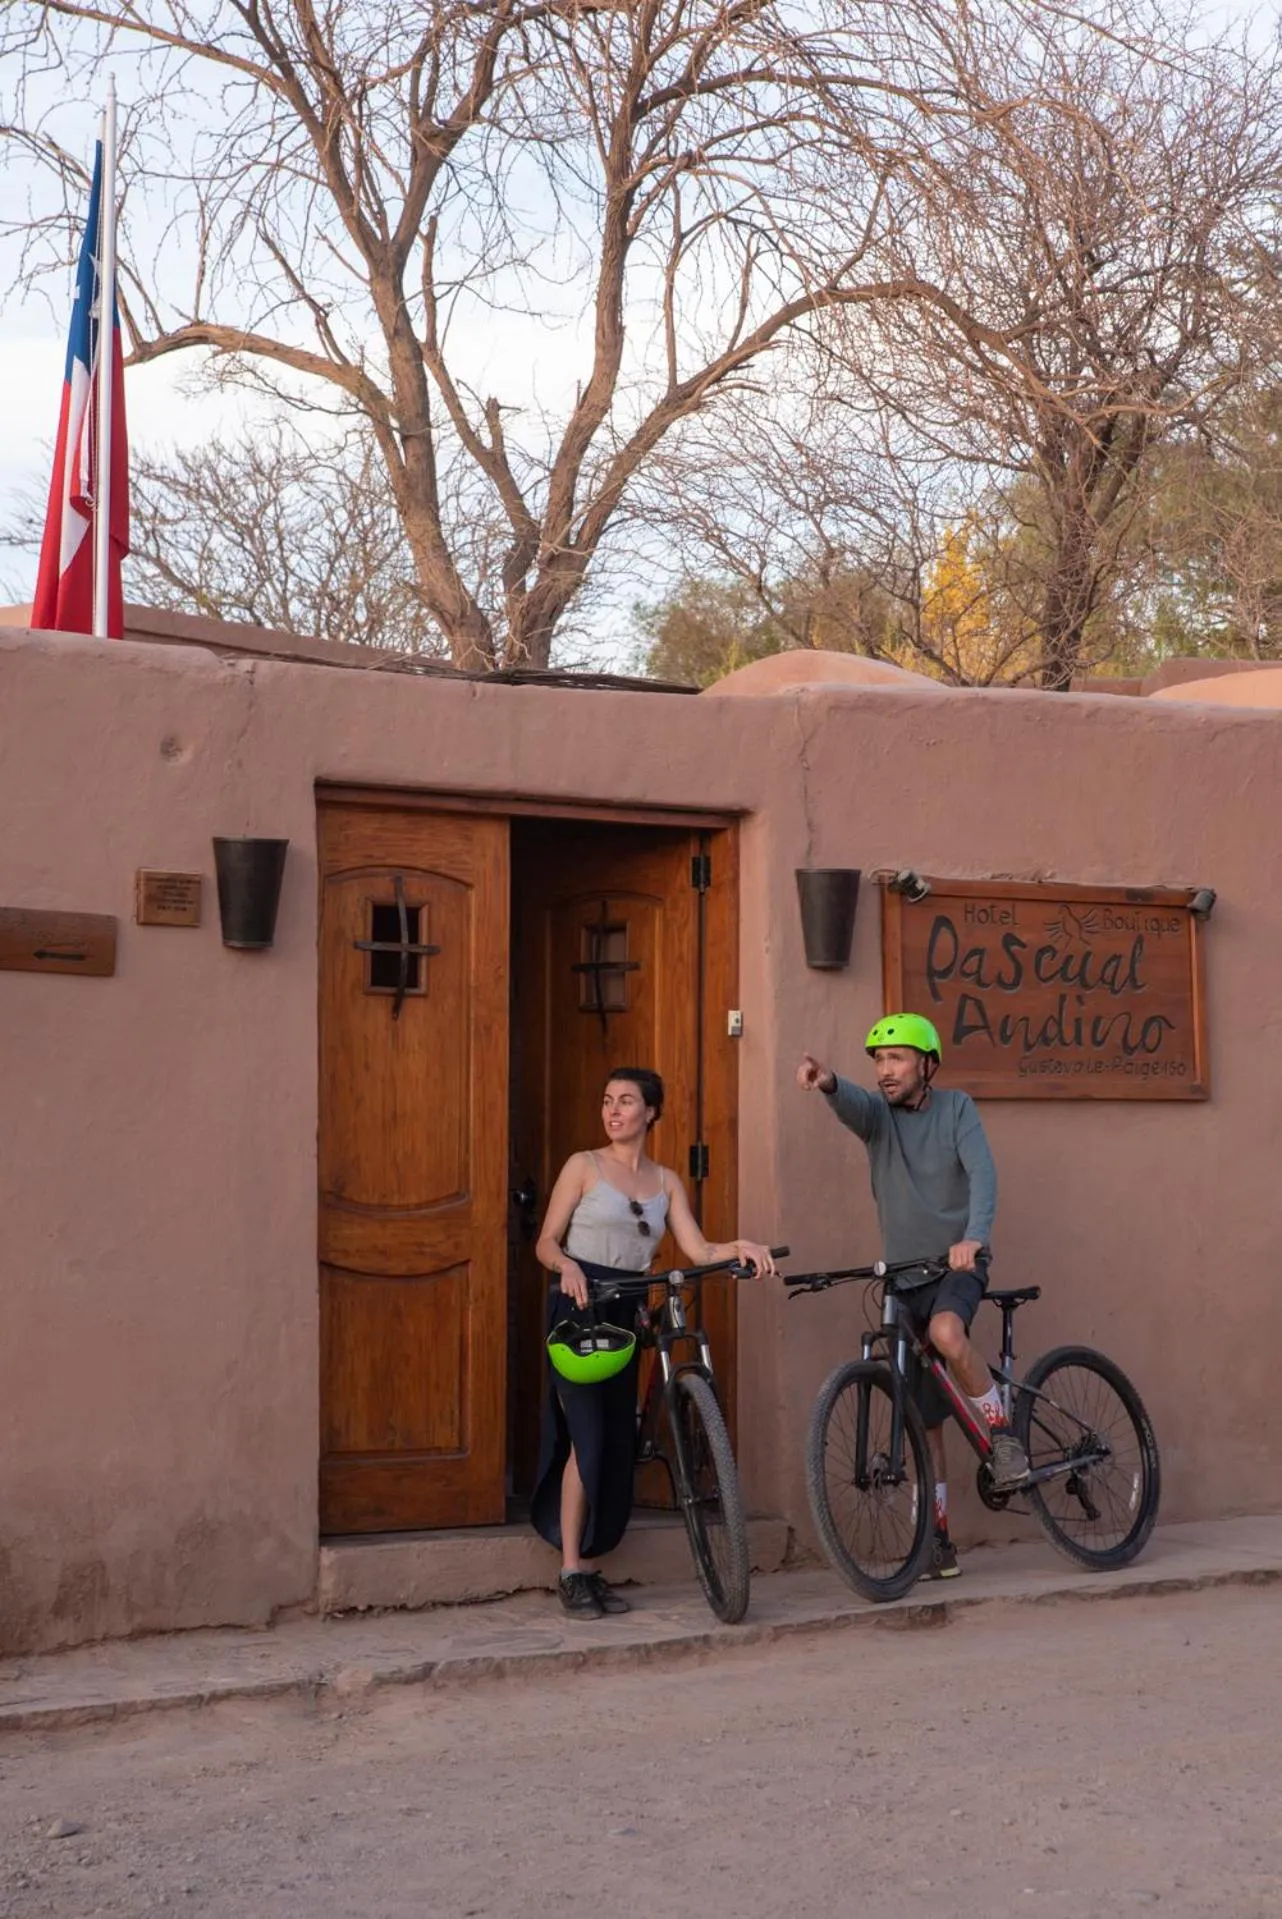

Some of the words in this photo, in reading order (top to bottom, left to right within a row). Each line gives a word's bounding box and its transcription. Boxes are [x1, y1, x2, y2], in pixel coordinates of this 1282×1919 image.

[964, 903, 1017, 926] Hotel
[1102, 908, 1180, 939] Boutique
[926, 915, 1148, 1001] Pascual
[953, 994, 1175, 1055] Andino
